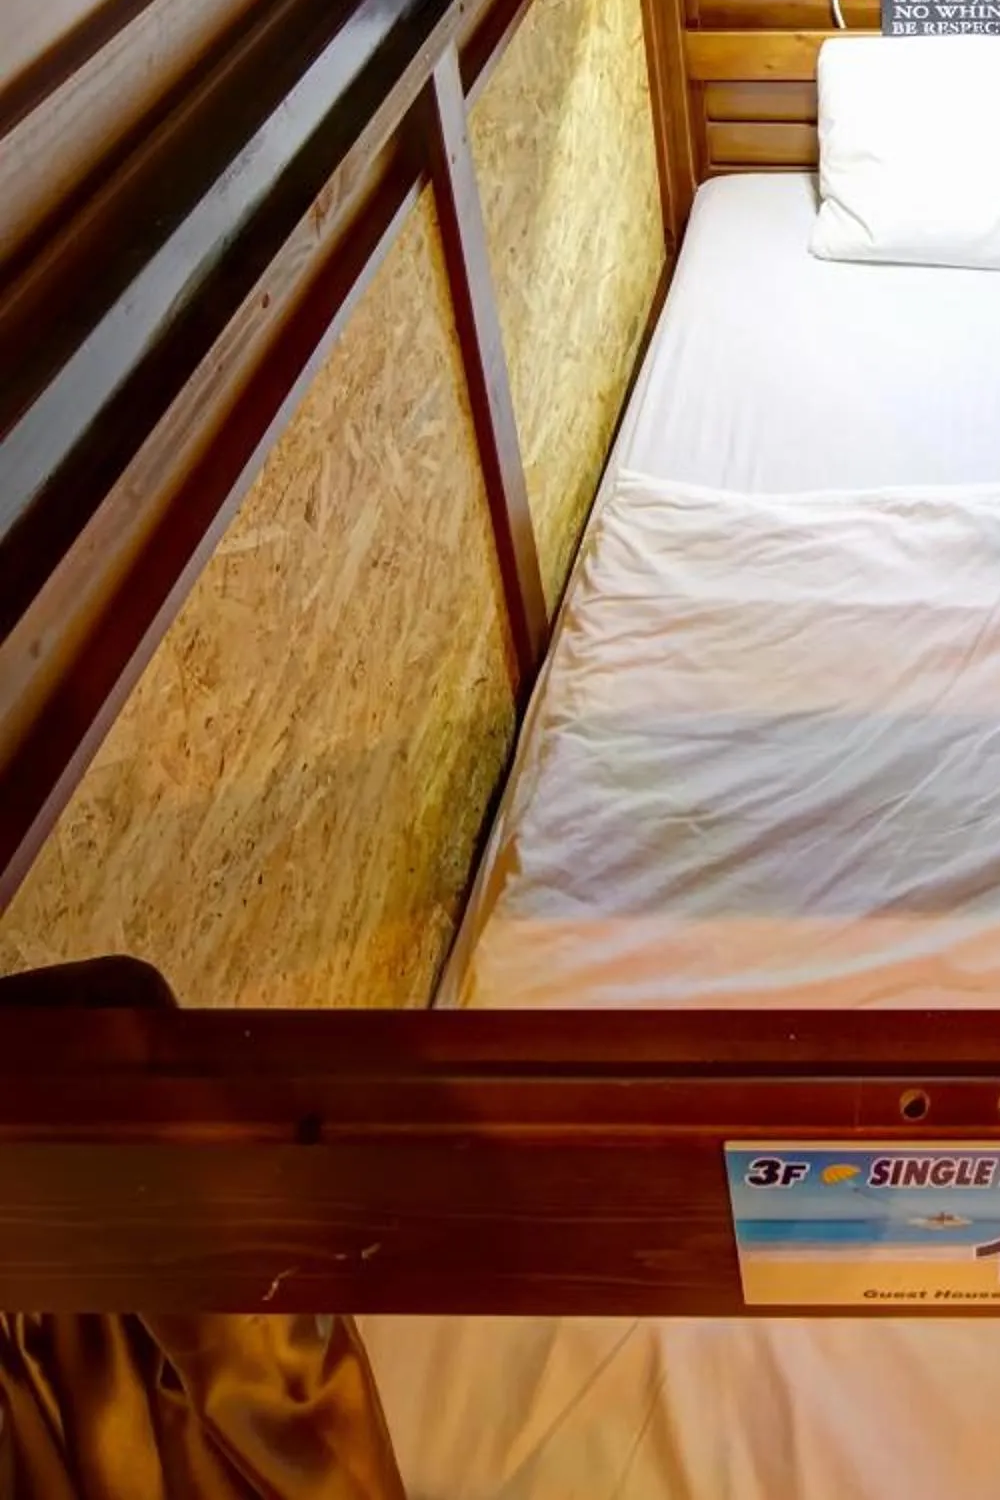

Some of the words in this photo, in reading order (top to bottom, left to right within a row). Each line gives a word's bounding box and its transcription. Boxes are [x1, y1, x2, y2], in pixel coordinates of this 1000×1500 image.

[893, 5, 929, 19] NO
[891, 21, 917, 35] BE
[745, 1156, 809, 1189] 3F
[867, 1156, 1000, 1189] SINGLE
[863, 1289, 928, 1299] Guest
